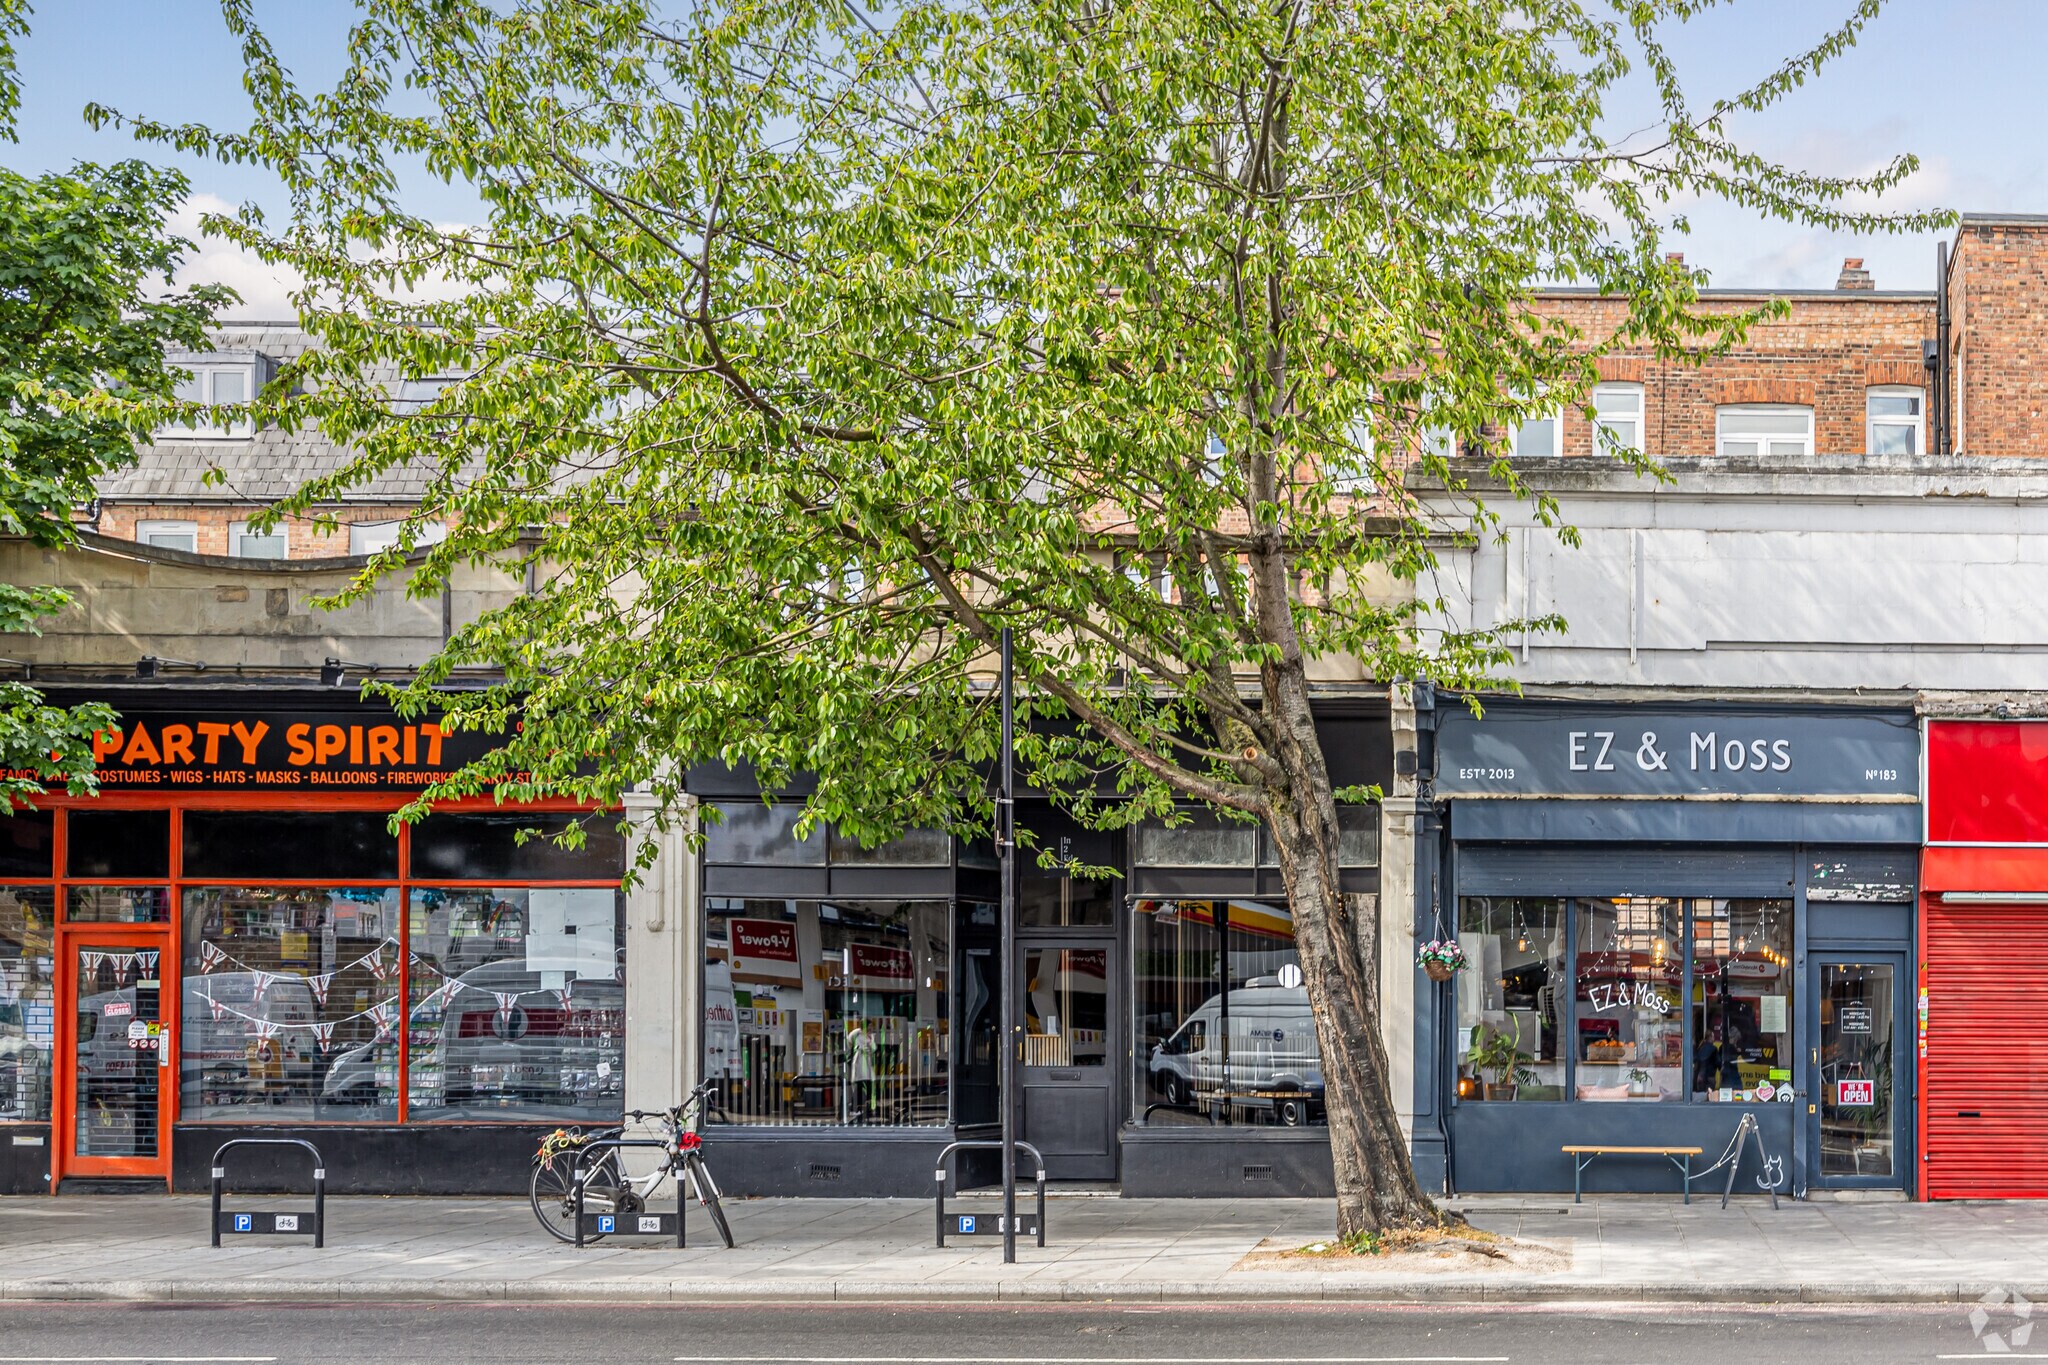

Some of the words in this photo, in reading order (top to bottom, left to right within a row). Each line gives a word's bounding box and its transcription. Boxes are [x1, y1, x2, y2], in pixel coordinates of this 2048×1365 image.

[93, 720, 270, 766] PARTY
[286, 722, 453, 767] SPIRIT
[1569, 731, 1615, 772] EZ
[1636, 731, 1669, 772] &
[0, 769, 39, 781] FANCY
[92, 770, 161, 783] COSTUMES
[171, 770, 203, 783] WIGS
[213, 771, 246, 784] HATS
[256, 771, 301, 784] MASKS
[310, 771, 378, 784] BALLOONS
[1489, 768, 1515, 779] 2013
[1588, 983, 1617, 1013] EZ
[1618, 982, 1631, 1007] &
[1843, 1090, 1869, 1103] OPEN
[239, 1217, 249, 1230] P
[602, 1218, 612, 1231] P
[962, 1218, 973, 1231] P
